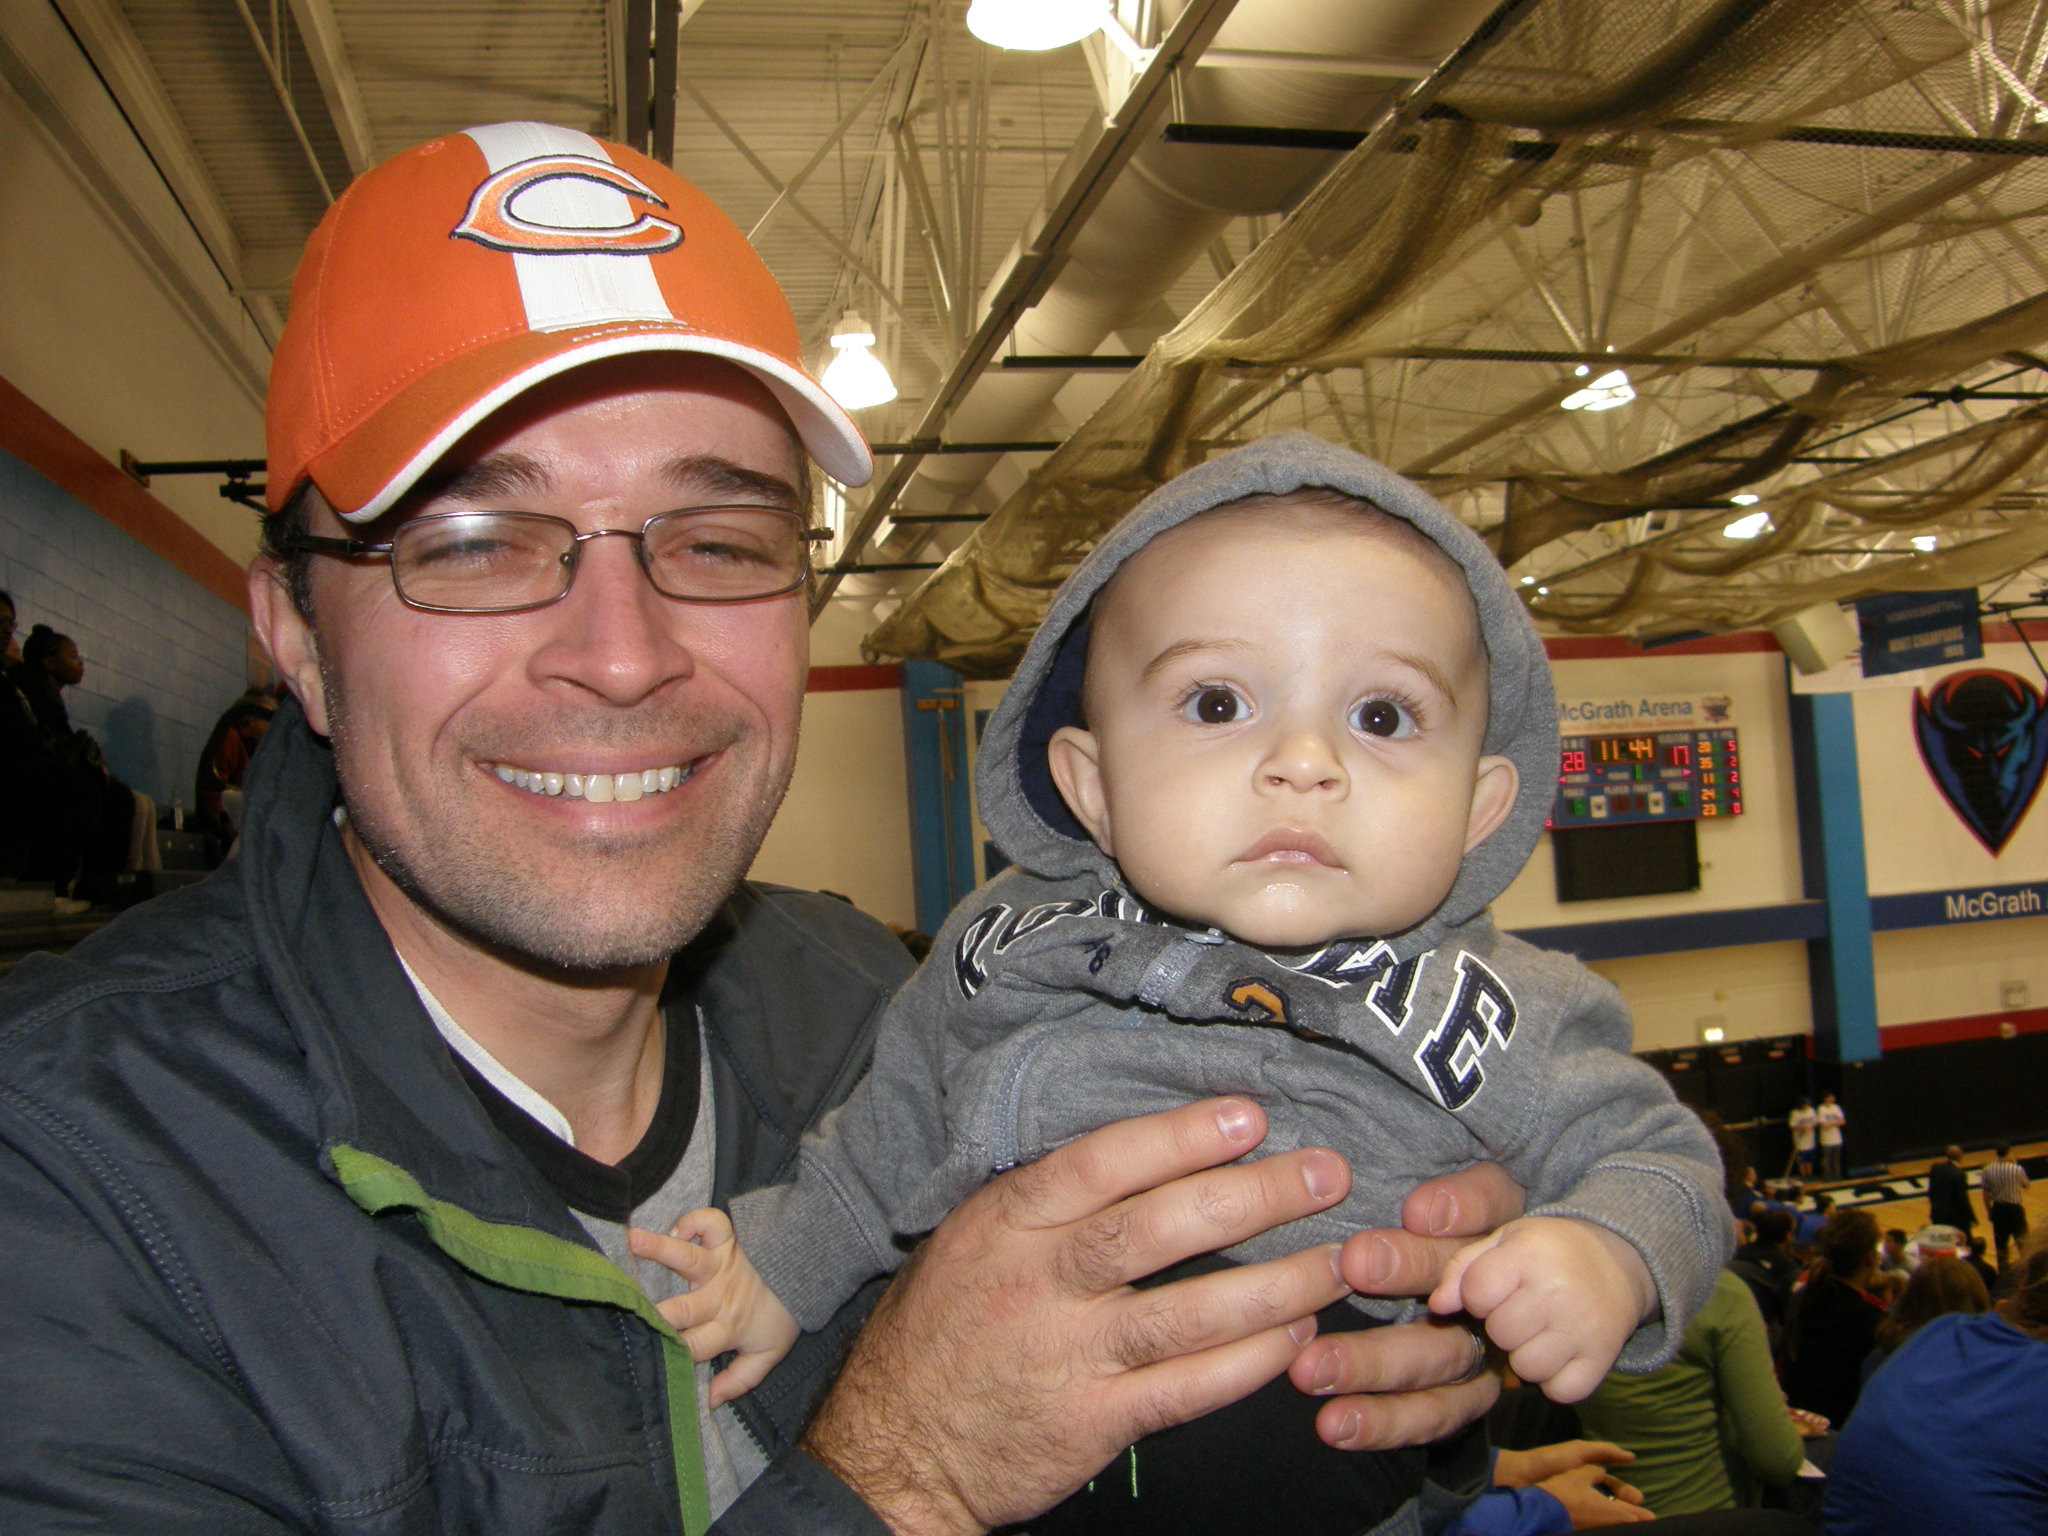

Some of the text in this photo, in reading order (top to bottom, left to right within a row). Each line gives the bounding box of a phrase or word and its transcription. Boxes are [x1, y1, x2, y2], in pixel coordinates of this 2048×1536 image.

[449, 154, 685, 256] C
[1639, 698, 1693, 717] Arena
[1562, 751, 1586, 773] 28
[1673, 745, 1690, 766] 17
[1944, 888, 2041, 920] McGrath
